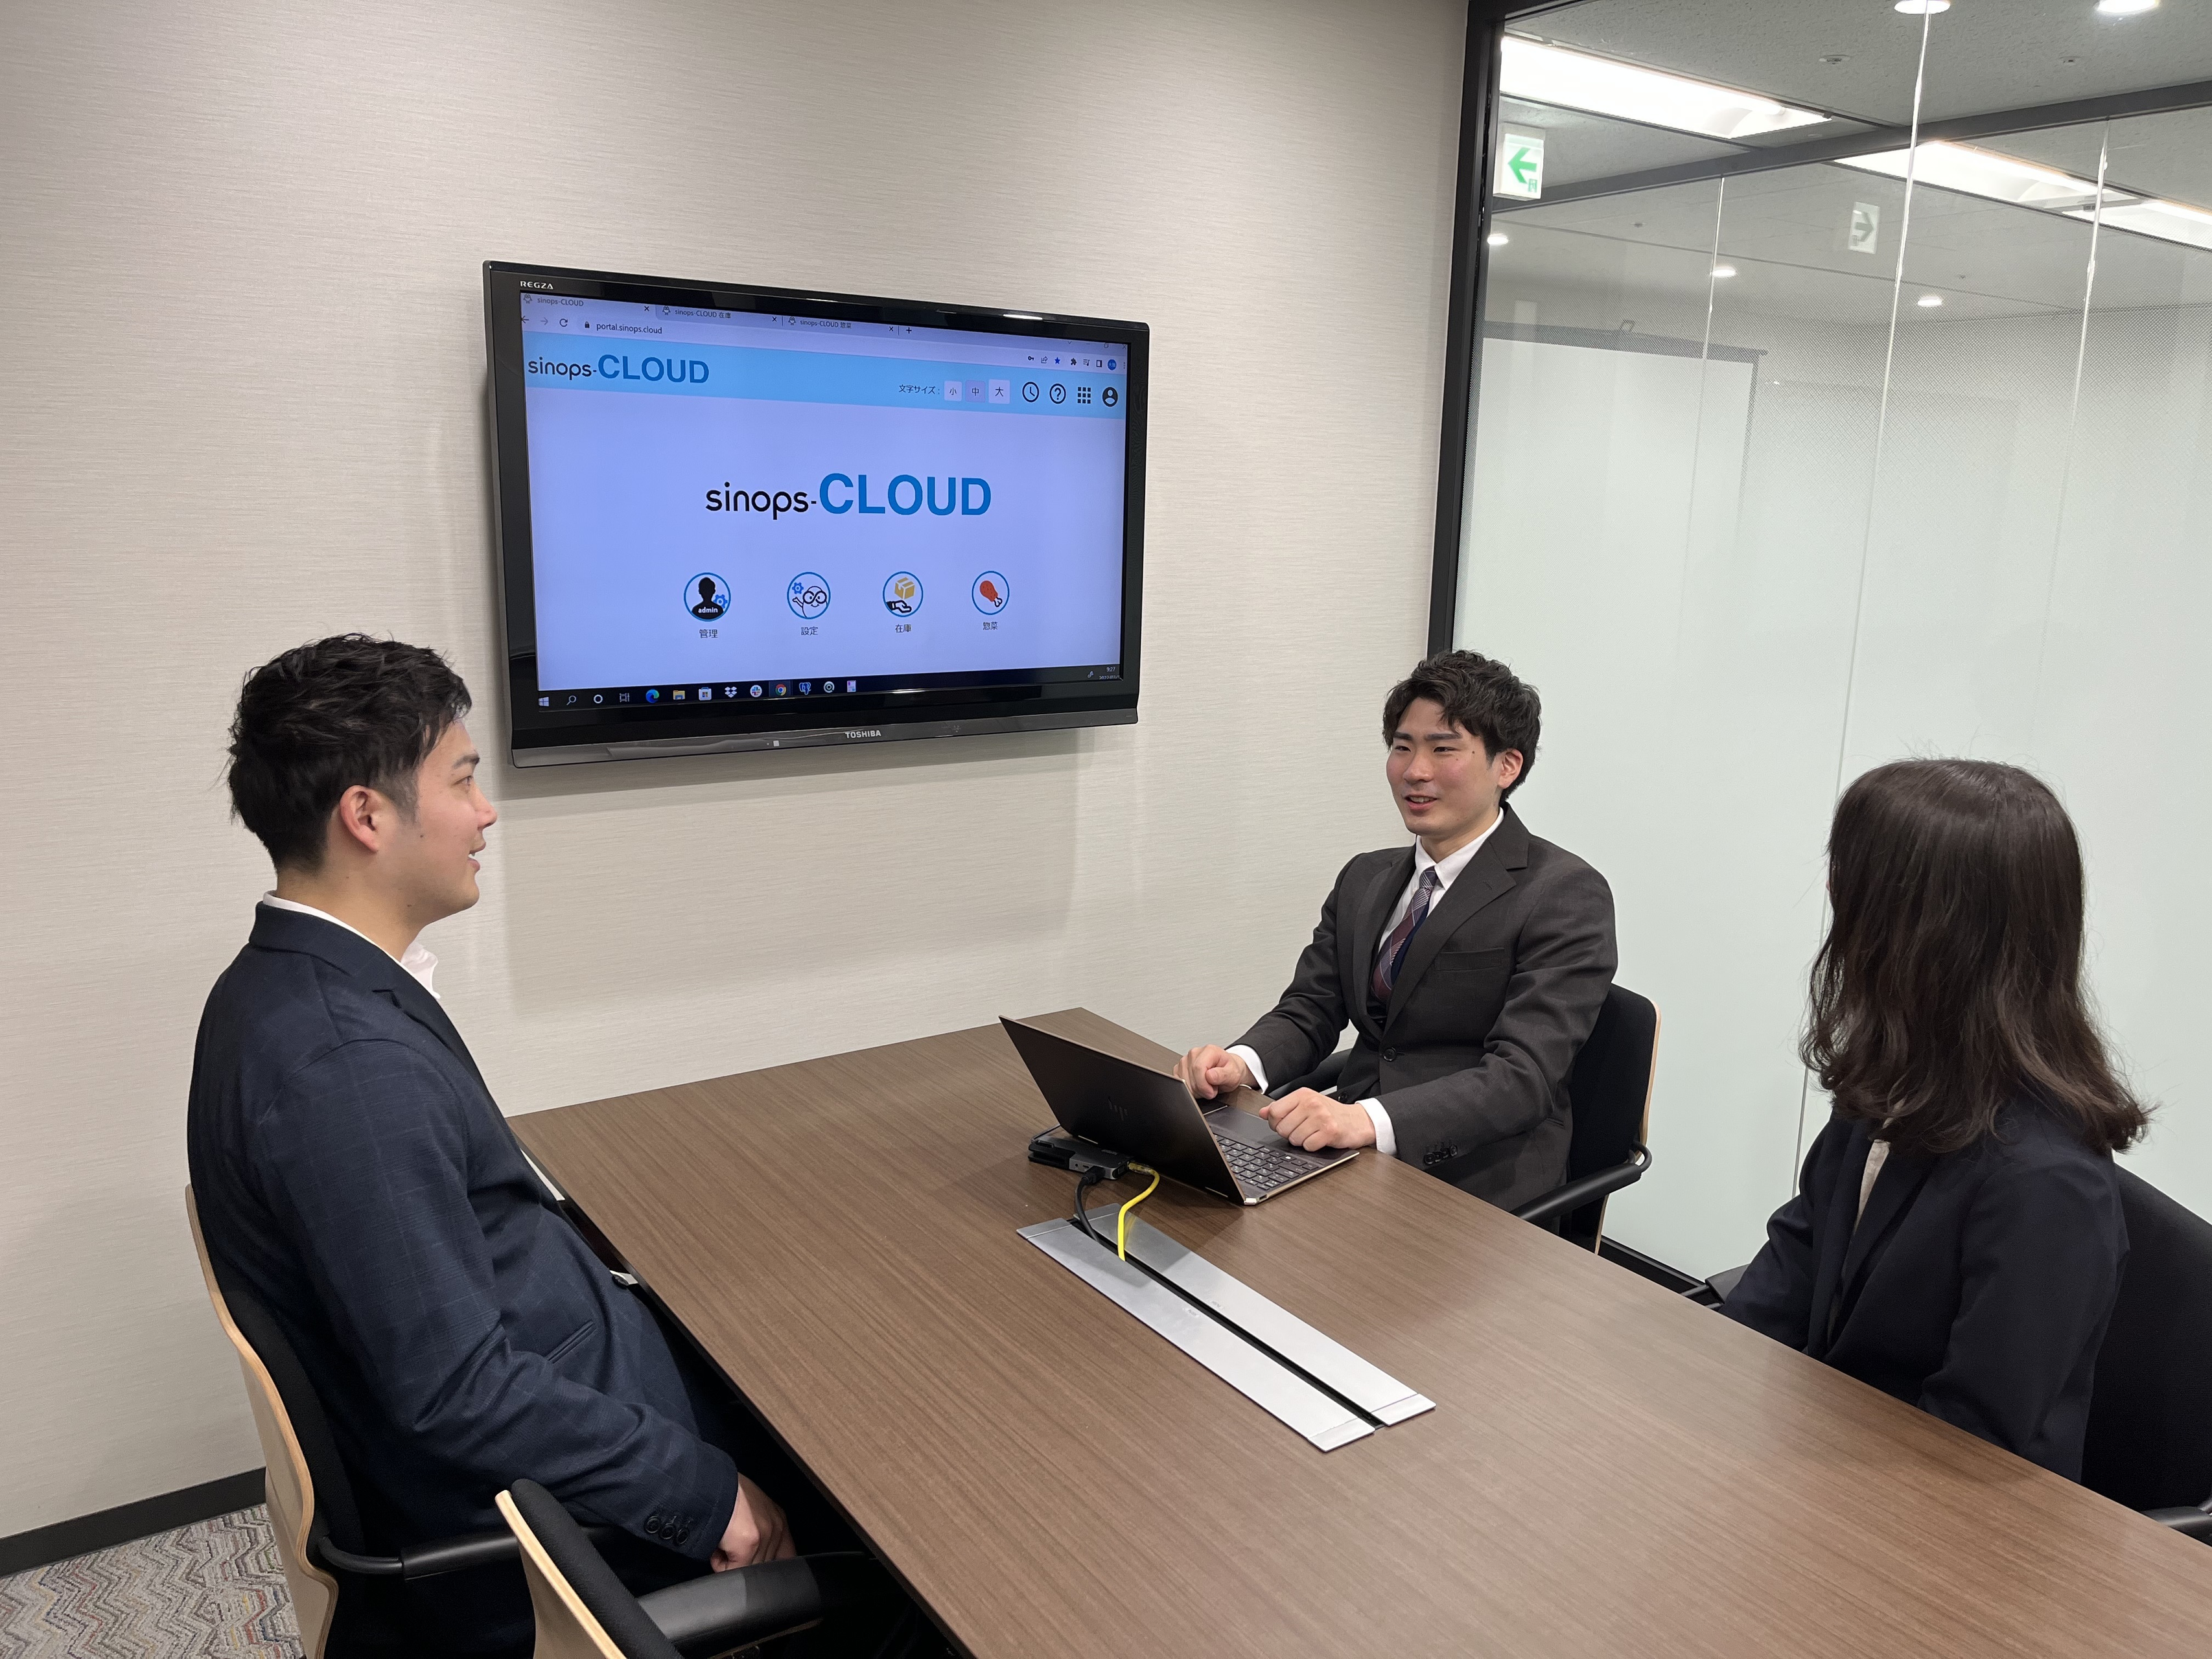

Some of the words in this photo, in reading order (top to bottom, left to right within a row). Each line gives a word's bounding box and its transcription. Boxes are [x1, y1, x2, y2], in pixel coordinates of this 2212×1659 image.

[520, 281, 554, 290] REGZA
[537, 297, 584, 307] sinops-CLOUD
[675, 309, 717, 318] sinops-CLOUD
[596, 323, 662, 334] portal.sinops.cloud
[800, 319, 839, 328] sinops-CLOUD
[528, 354, 710, 384] sinops-CLOUD
[949, 387, 957, 396] 小
[972, 387, 979, 397] 中
[995, 386, 1004, 397] 大
[705, 473, 992, 520] sinops-CLOUD
[800, 626, 819, 636] 設定
[895, 623, 912, 633] 在庫
[983, 621, 998, 631] 惣菜
[699, 629, 719, 639] 管理
[844, 730, 882, 739] TOSHIBA
